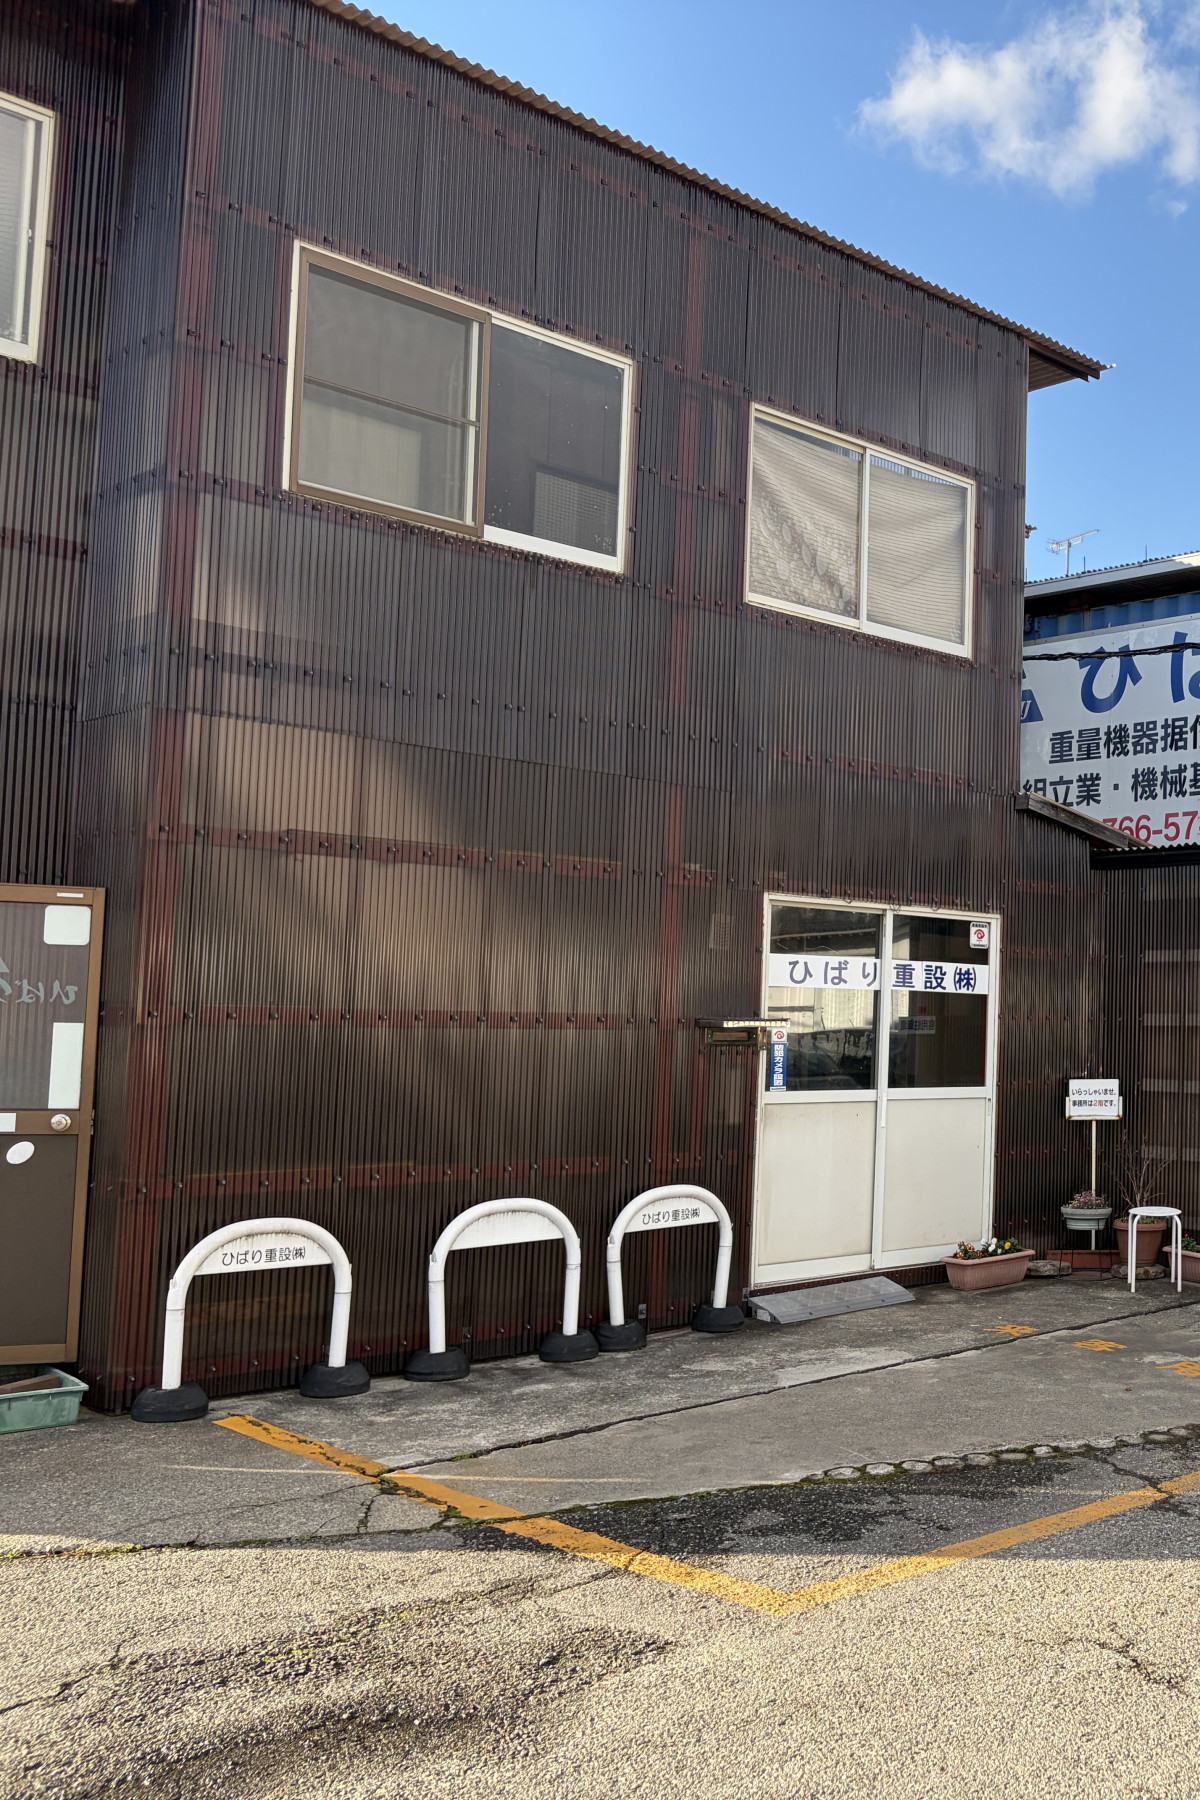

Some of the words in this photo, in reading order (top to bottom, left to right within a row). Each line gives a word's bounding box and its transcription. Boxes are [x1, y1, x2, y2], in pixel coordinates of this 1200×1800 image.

[788, 959, 977, 993] ひばり重設(株)
[1071, 1088, 1117, 1096] いらっしゃいませ。
[642, 1206, 701, 1225] ひばり重設(株)
[221, 1246, 306, 1266] ひばり重設(株)
